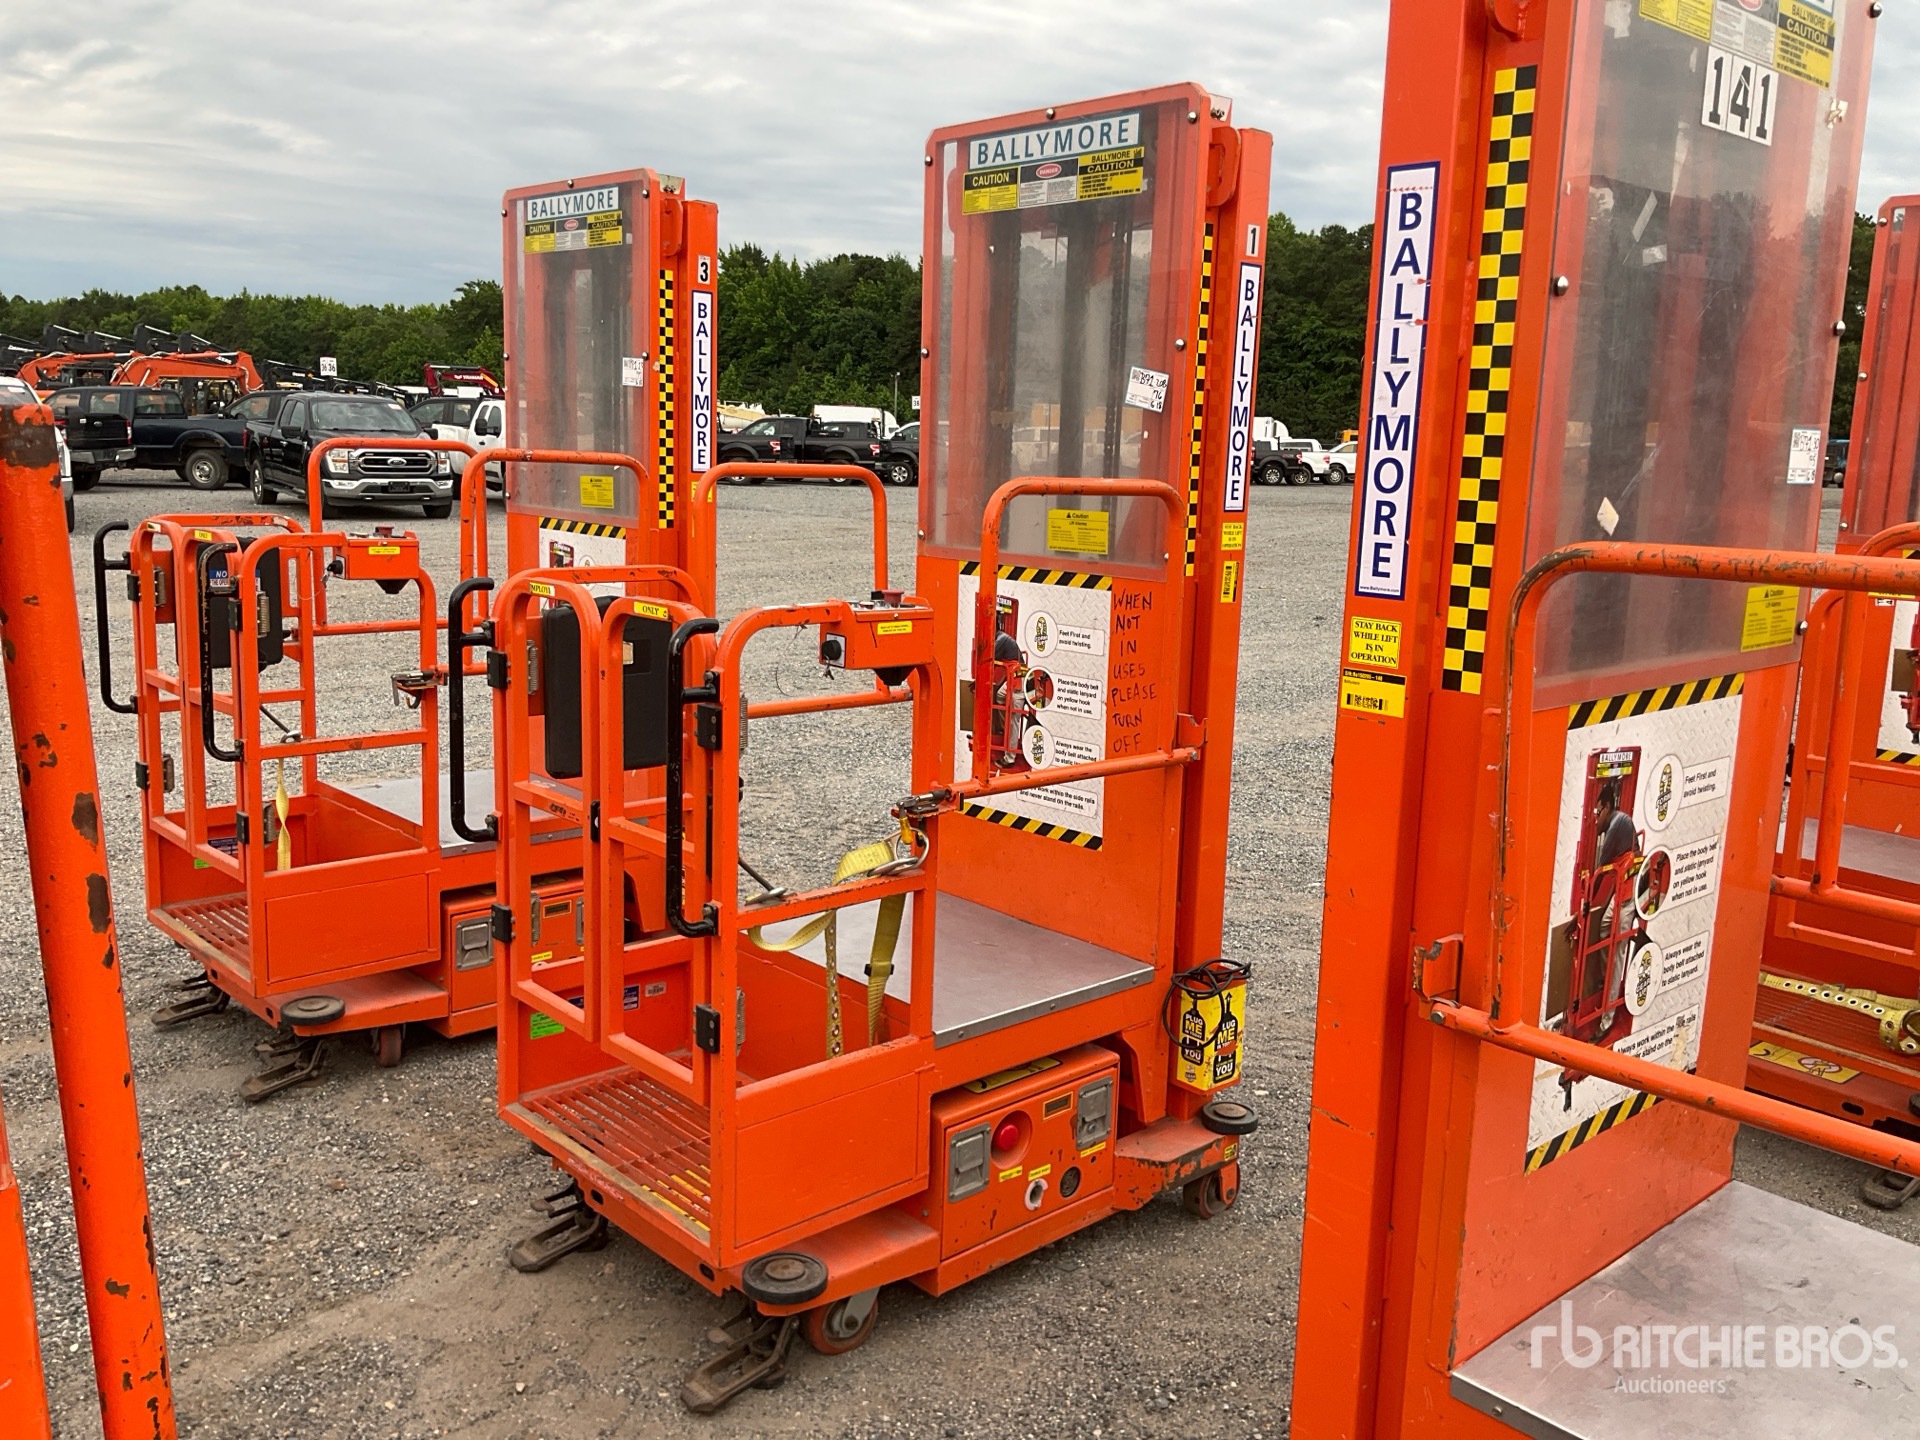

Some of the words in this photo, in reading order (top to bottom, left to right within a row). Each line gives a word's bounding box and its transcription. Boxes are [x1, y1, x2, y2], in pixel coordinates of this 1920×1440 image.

[1791, 4, 1826, 30] BALLYMORE
[1787, 19, 1828, 46] CAUTION
[1708, 56, 1771, 140] 141
[977, 117, 1131, 166] BALLYMORE
[1092, 151, 1130, 163] BALLYMORE
[1087, 159, 1134, 174] CAUTION
[972, 172, 1009, 187] CAUTION
[531, 190, 613, 218] BALLYMORE
[529, 224, 550, 234] CAUTION
[592, 220, 617, 229] CAUTION
[1250, 226, 1257, 255] 1
[700, 262, 708, 282] 3
[694, 303, 709, 464] BALLYMORE
[1231, 279, 1254, 501] BALLYMORE
[1371, 192, 1422, 578] BALLYMORE
[1114, 588, 1152, 610] WHEN
[642, 606, 659, 616] ONLY
[1116, 614, 1141, 634] NOT
[1355, 621, 1373, 630] STAY
[1375, 623, 1398, 633] BACK
[1353, 631, 1379, 641] WHILE
[1381, 634, 1398, 643] LIFT
[1121, 640, 1136, 657] IN
[1365, 643, 1372, 651] IS
[1374, 644, 1384, 652] IN
[1351, 652, 1397, 665] OPERATION
[1080, 690, 1096, 698] lanyard
[1111, 682, 1157, 707] PLEASE
[1112, 708, 1142, 727] TURN
[1056, 740, 1071, 749] Always
[1113, 732, 1142, 753] OFF
[1077, 754, 1096, 762] attached
[1601, 752, 1632, 762] BALLYMORE
[1685, 775, 1695, 784] Feet
[1696, 772, 1707, 781] First
[1708, 769, 1716, 778] and
[1043, 795, 1056, 803] stand
[1050, 789, 1064, 797] within
[1684, 787, 1696, 798] avoid
[1676, 853, 1689, 862] Place
[1697, 845, 1708, 855] body
[1709, 842, 1717, 851] belt
[1674, 865, 1684, 875] and
[1684, 862, 1697, 873] static
[1697, 856, 1713, 870] lanyard
[1673, 881, 1679, 889] on
[1680, 876, 1694, 888] yellow
[1695, 870, 1707, 880] hook
[1671, 892, 1684, 901] when
[1665, 949, 1681, 961] Always
[1682, 944, 1693, 953] wear
[1663, 964, 1675, 974] body
[1676, 959, 1685, 969] belt
[1685, 950, 1704, 964] attached
[1668, 974, 1681, 985] static
[1186, 1014, 1203, 1025] PLUG
[1186, 1020, 1202, 1034] ME
[1221, 1020, 1235, 1030] LUG
[1218, 1028, 1235, 1044] ME
[1637, 1036, 1650, 1048] work
[1651, 1029, 1666, 1041] within
[1666, 1025, 1674, 1033] the
[1185, 1049, 1201, 1060] YOU
[1642, 1044, 1656, 1057] stand
[1657, 1041, 1664, 1050] on
[1665, 1037, 1673, 1046] the
[1216, 1062, 1233, 1076] YOU
